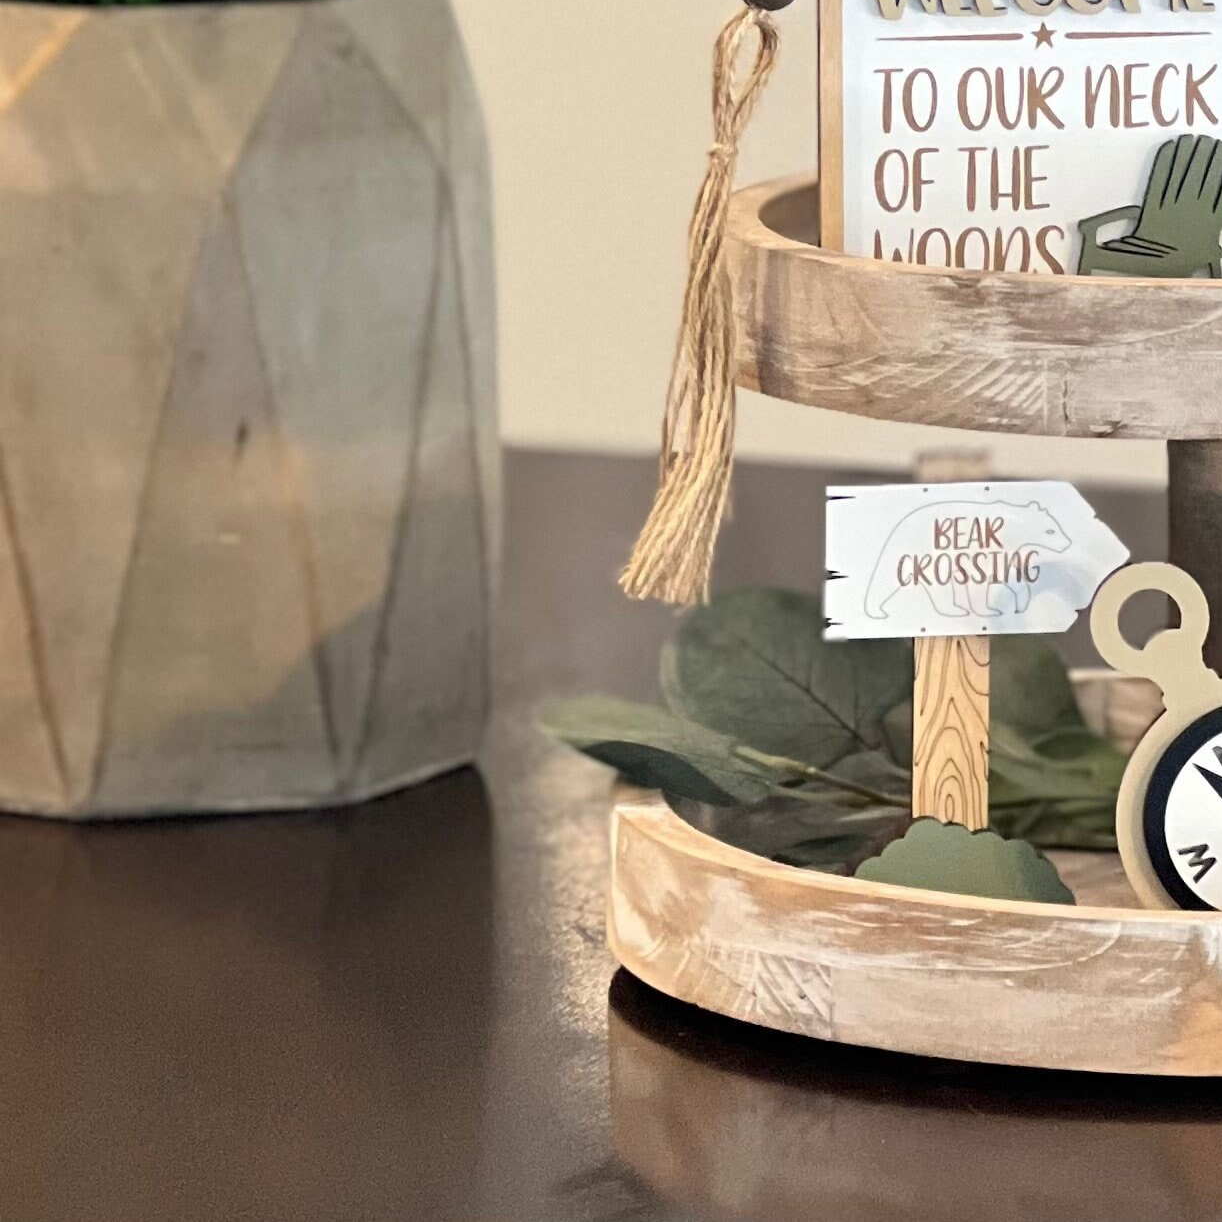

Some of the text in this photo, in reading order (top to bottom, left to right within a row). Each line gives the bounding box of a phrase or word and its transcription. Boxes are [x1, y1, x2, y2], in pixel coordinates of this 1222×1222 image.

[874, 63, 1219, 133] TO OUR NECK
[874, 145, 1050, 213] OF THE
[933, 516, 1005, 550] BEAR
[896, 550, 1041, 587] CROSSING
